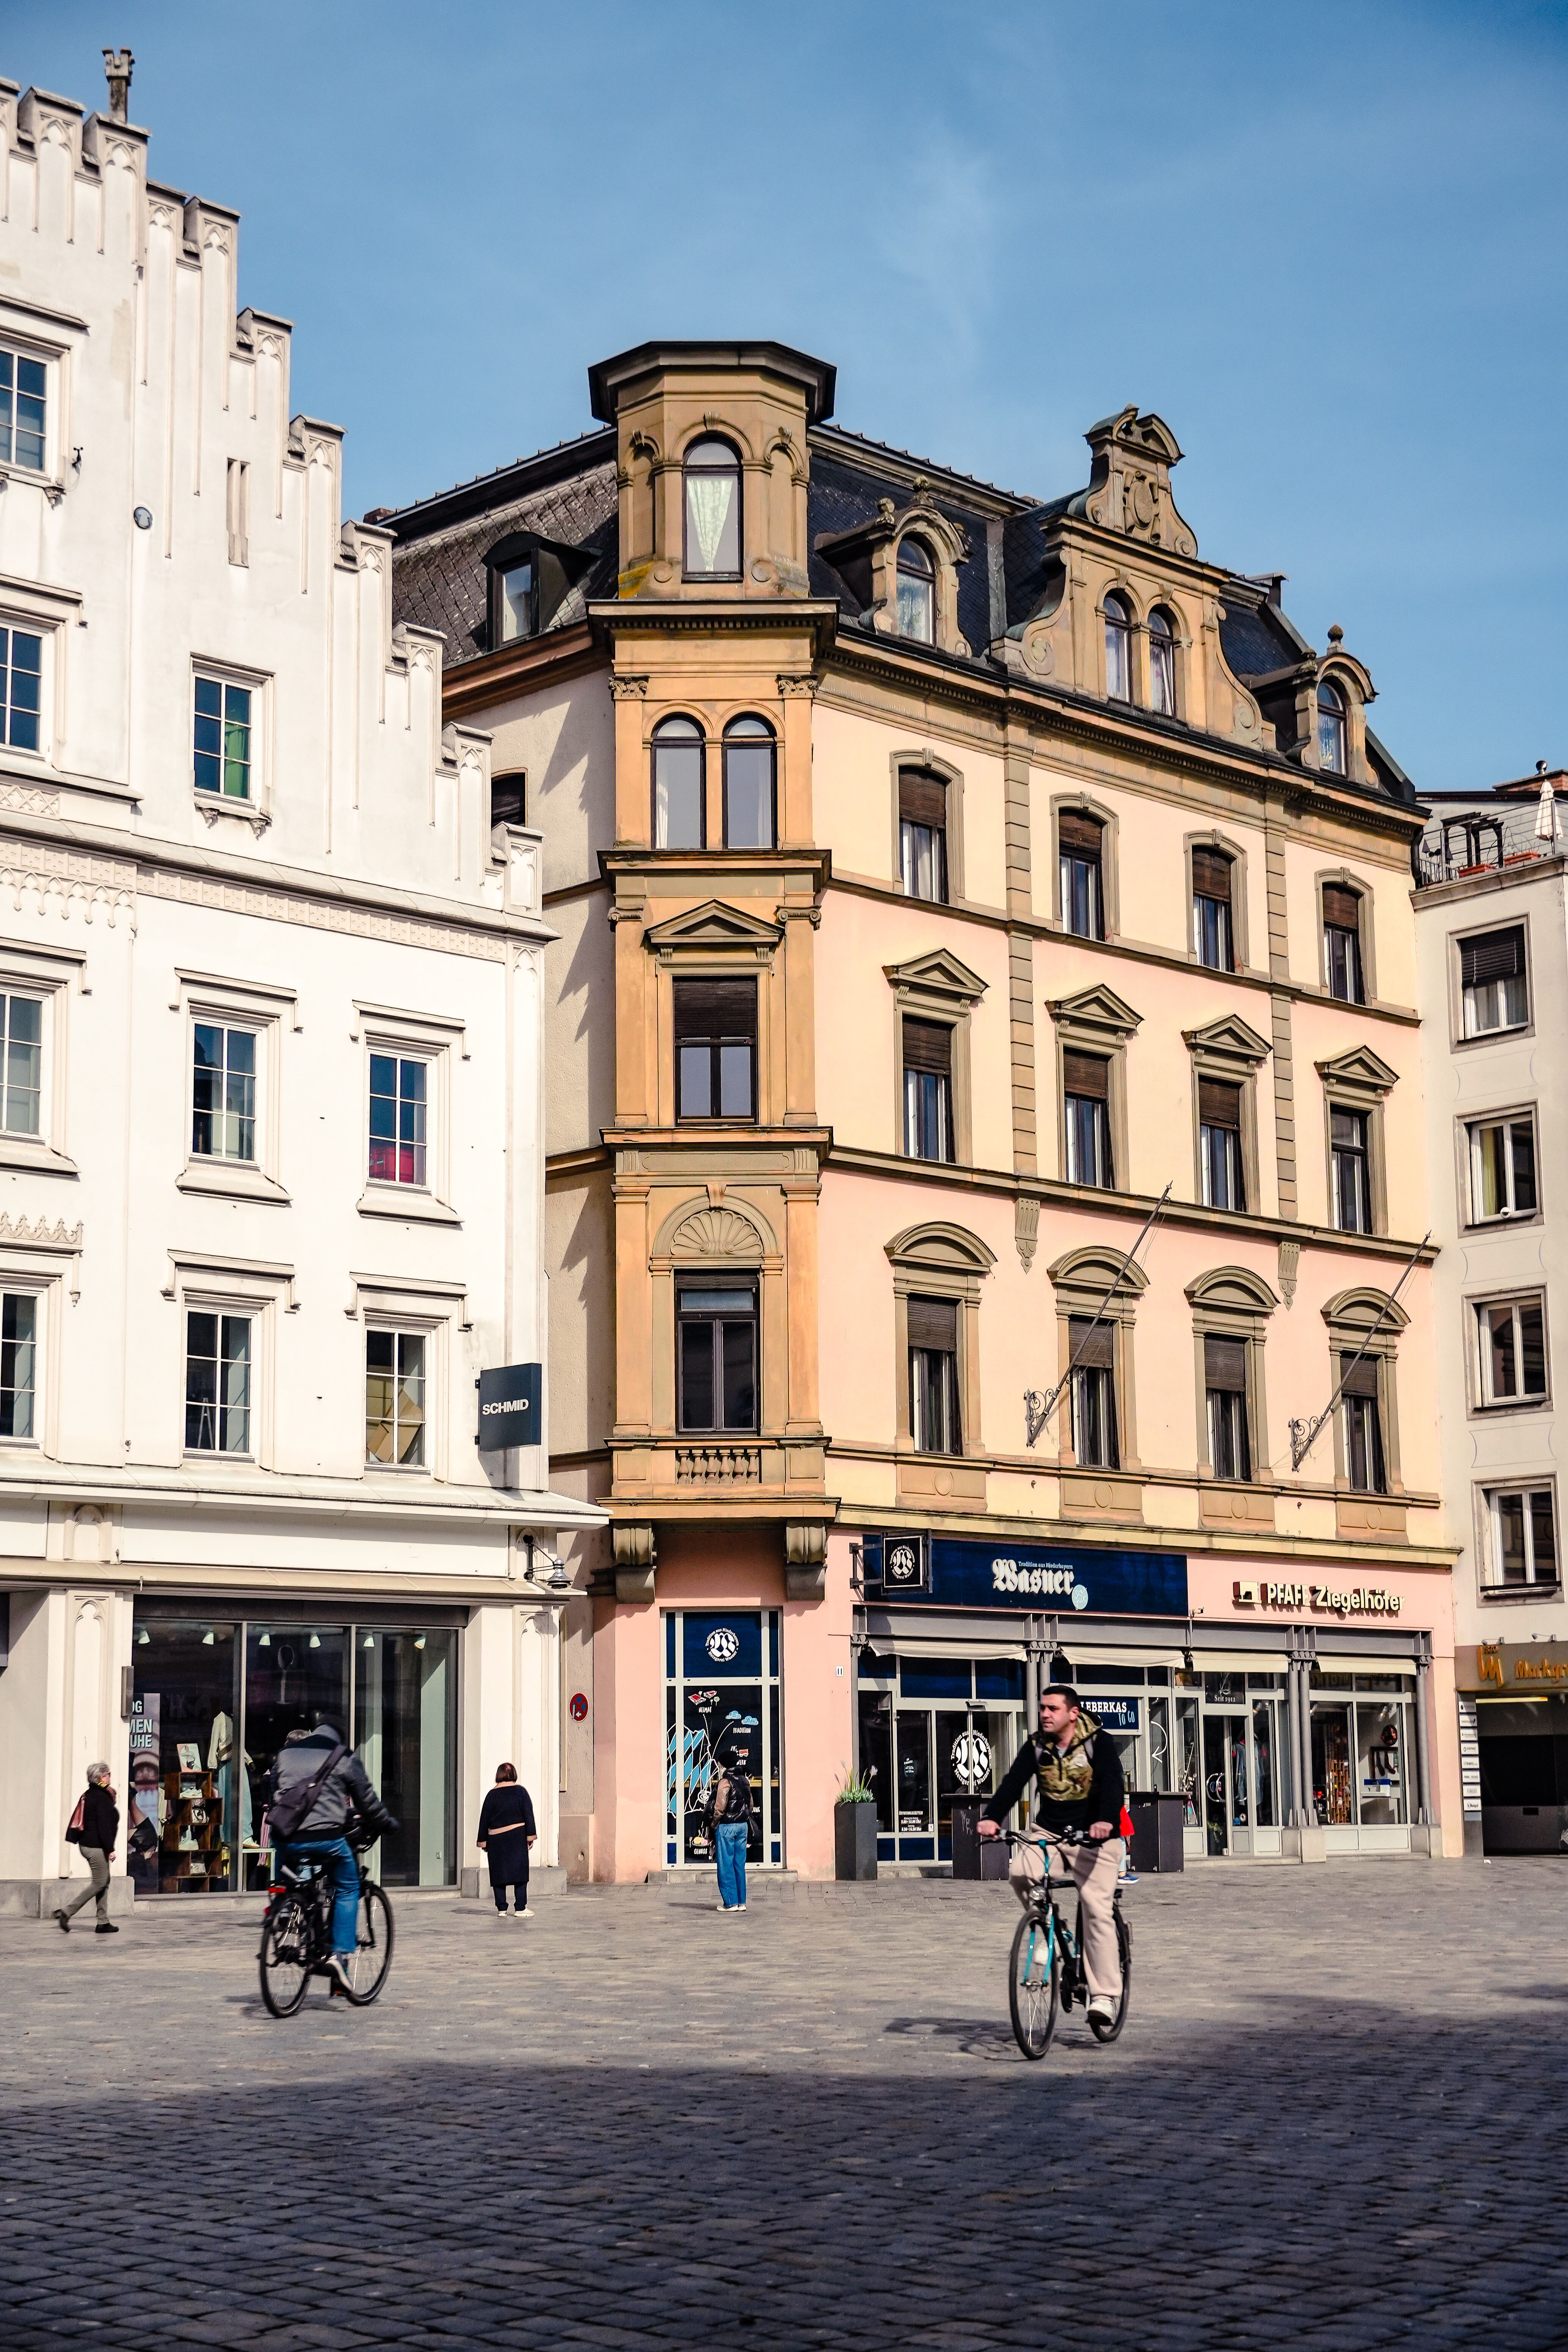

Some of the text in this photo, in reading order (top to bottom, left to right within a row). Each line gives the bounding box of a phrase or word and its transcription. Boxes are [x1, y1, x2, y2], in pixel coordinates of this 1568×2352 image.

[482, 1399, 529, 1415] SCHMID
[992, 1559, 1075, 1595] Wasner
[1267, 1582, 1405, 1613] PFAFF Ziegelhöfer
[1118, 1713, 1126, 1726] TO
[1127, 1710, 1135, 1723] GO
[951, 1734, 962, 1760] Tradition
[973, 1729, 992, 1759] Niederbayern
[977, 1767, 990, 1785] Wasner
